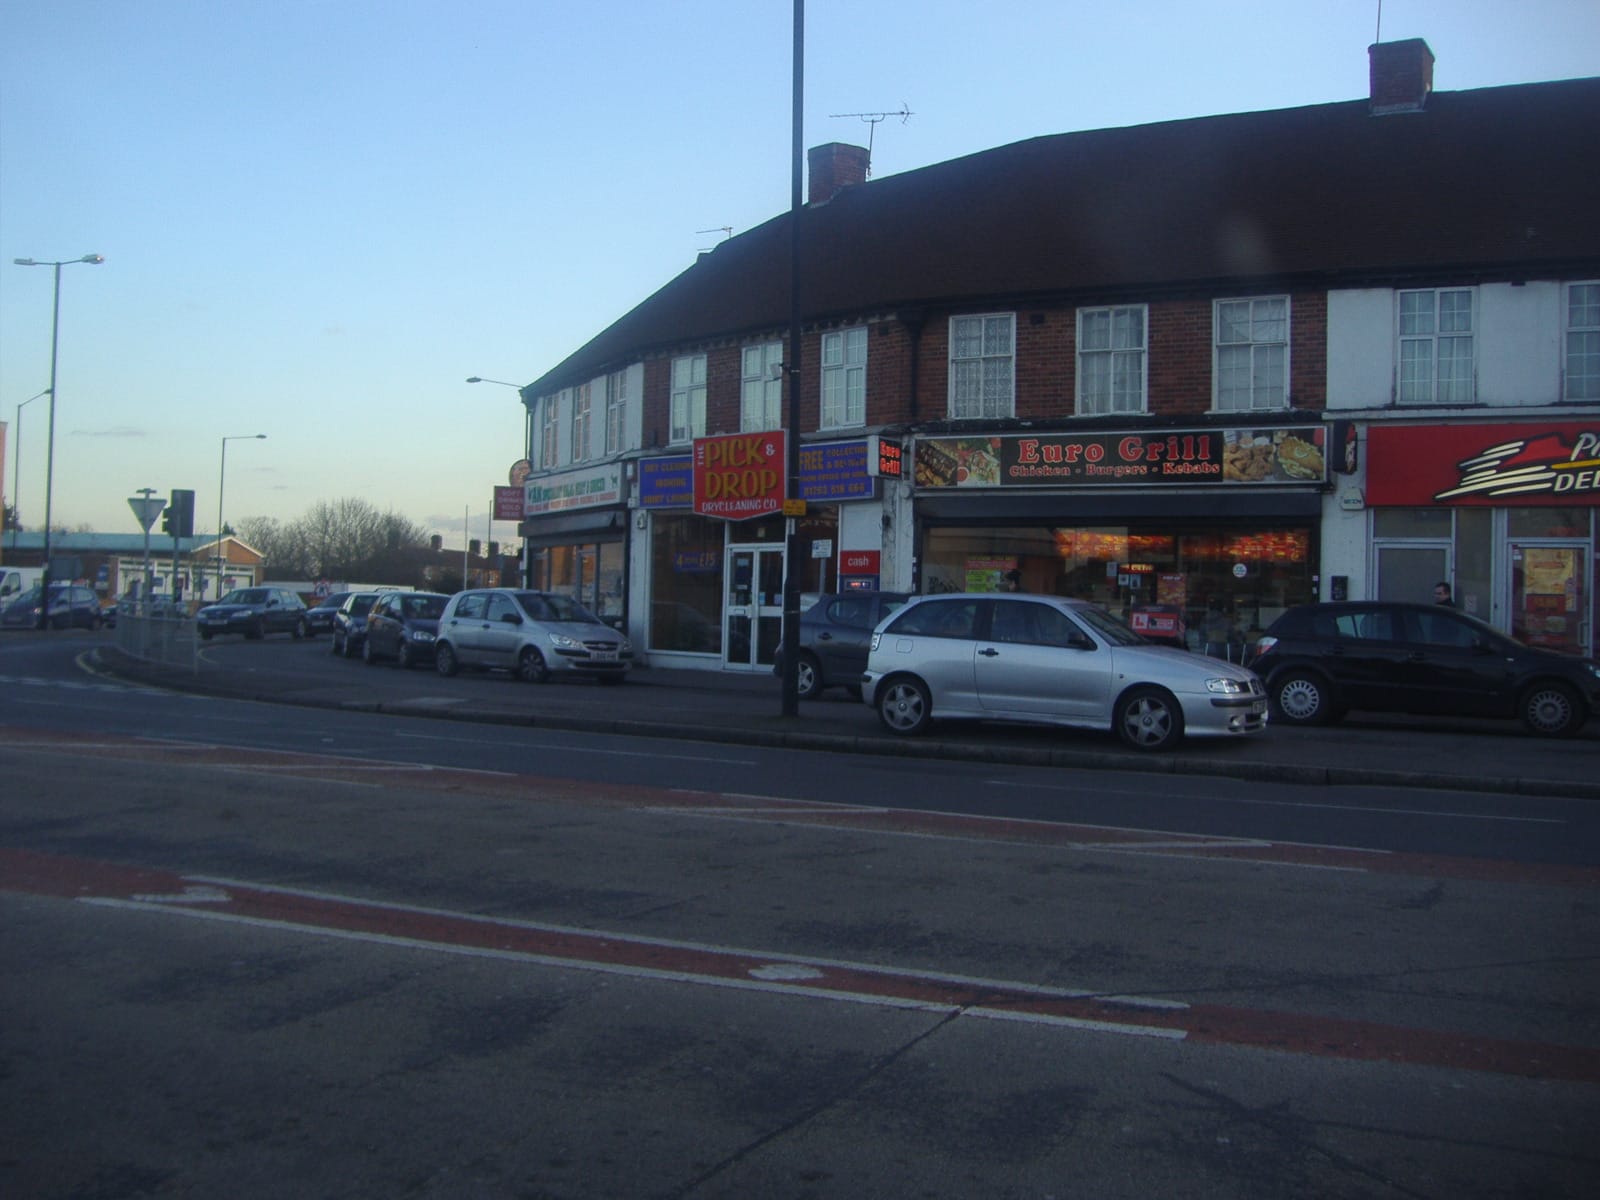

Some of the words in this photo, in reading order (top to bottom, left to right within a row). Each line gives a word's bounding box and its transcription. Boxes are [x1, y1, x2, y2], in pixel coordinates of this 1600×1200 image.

[705, 437, 767, 468] PICK
[765, 443, 776, 456] &
[1018, 437, 1104, 463] Euro
[1118, 434, 1210, 462] Grill
[1009, 464, 1071, 477] Chicken
[1086, 463, 1147, 477] Burgers
[1162, 461, 1220, 475] Kebabs
[705, 469, 777, 498] DROP
[702, 499, 761, 512] DRYCLEANING
[763, 499, 777, 510] CO
[848, 555, 869, 567] cash
